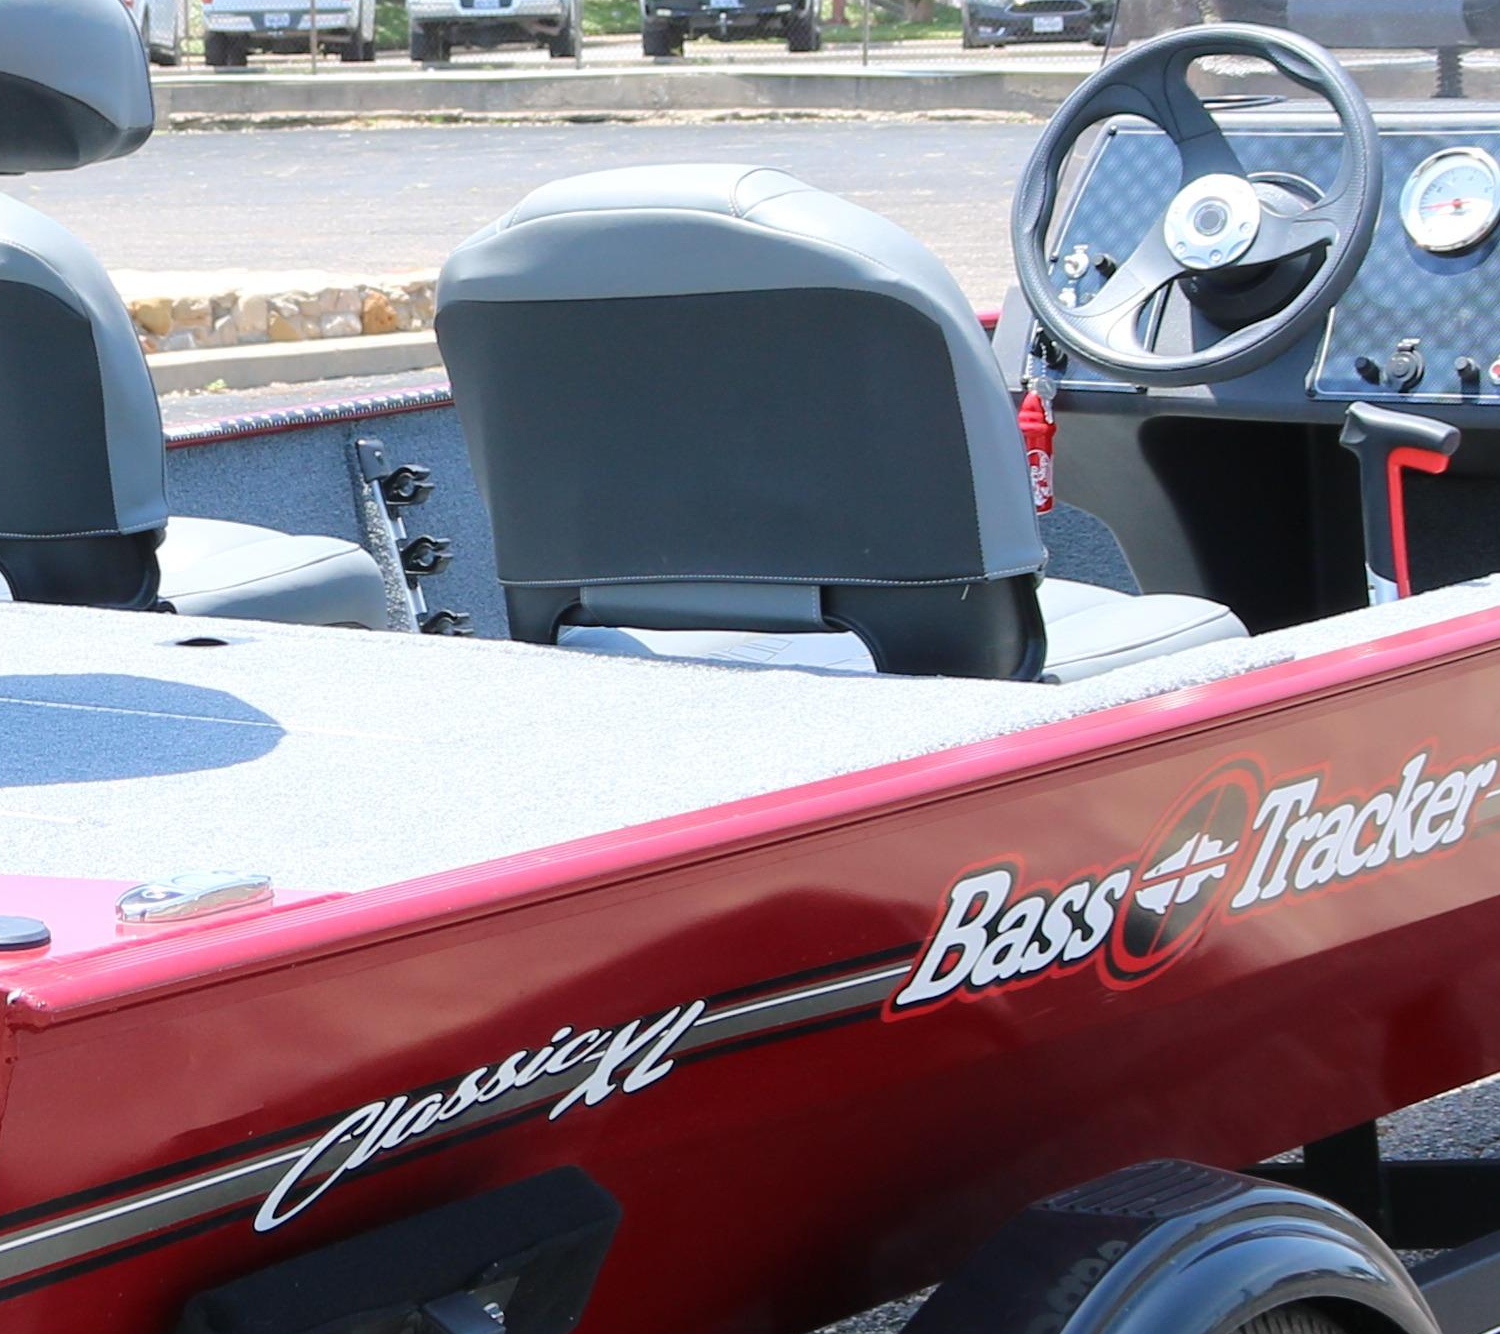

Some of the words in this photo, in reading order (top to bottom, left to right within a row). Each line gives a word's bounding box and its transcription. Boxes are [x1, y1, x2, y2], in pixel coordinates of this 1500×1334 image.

[896, 869, 1130, 1006] Bass
[1231, 753, 1498, 909] Tracker
[254, 1026, 611, 1232] Classic
[549, 999, 706, 1121] XL
